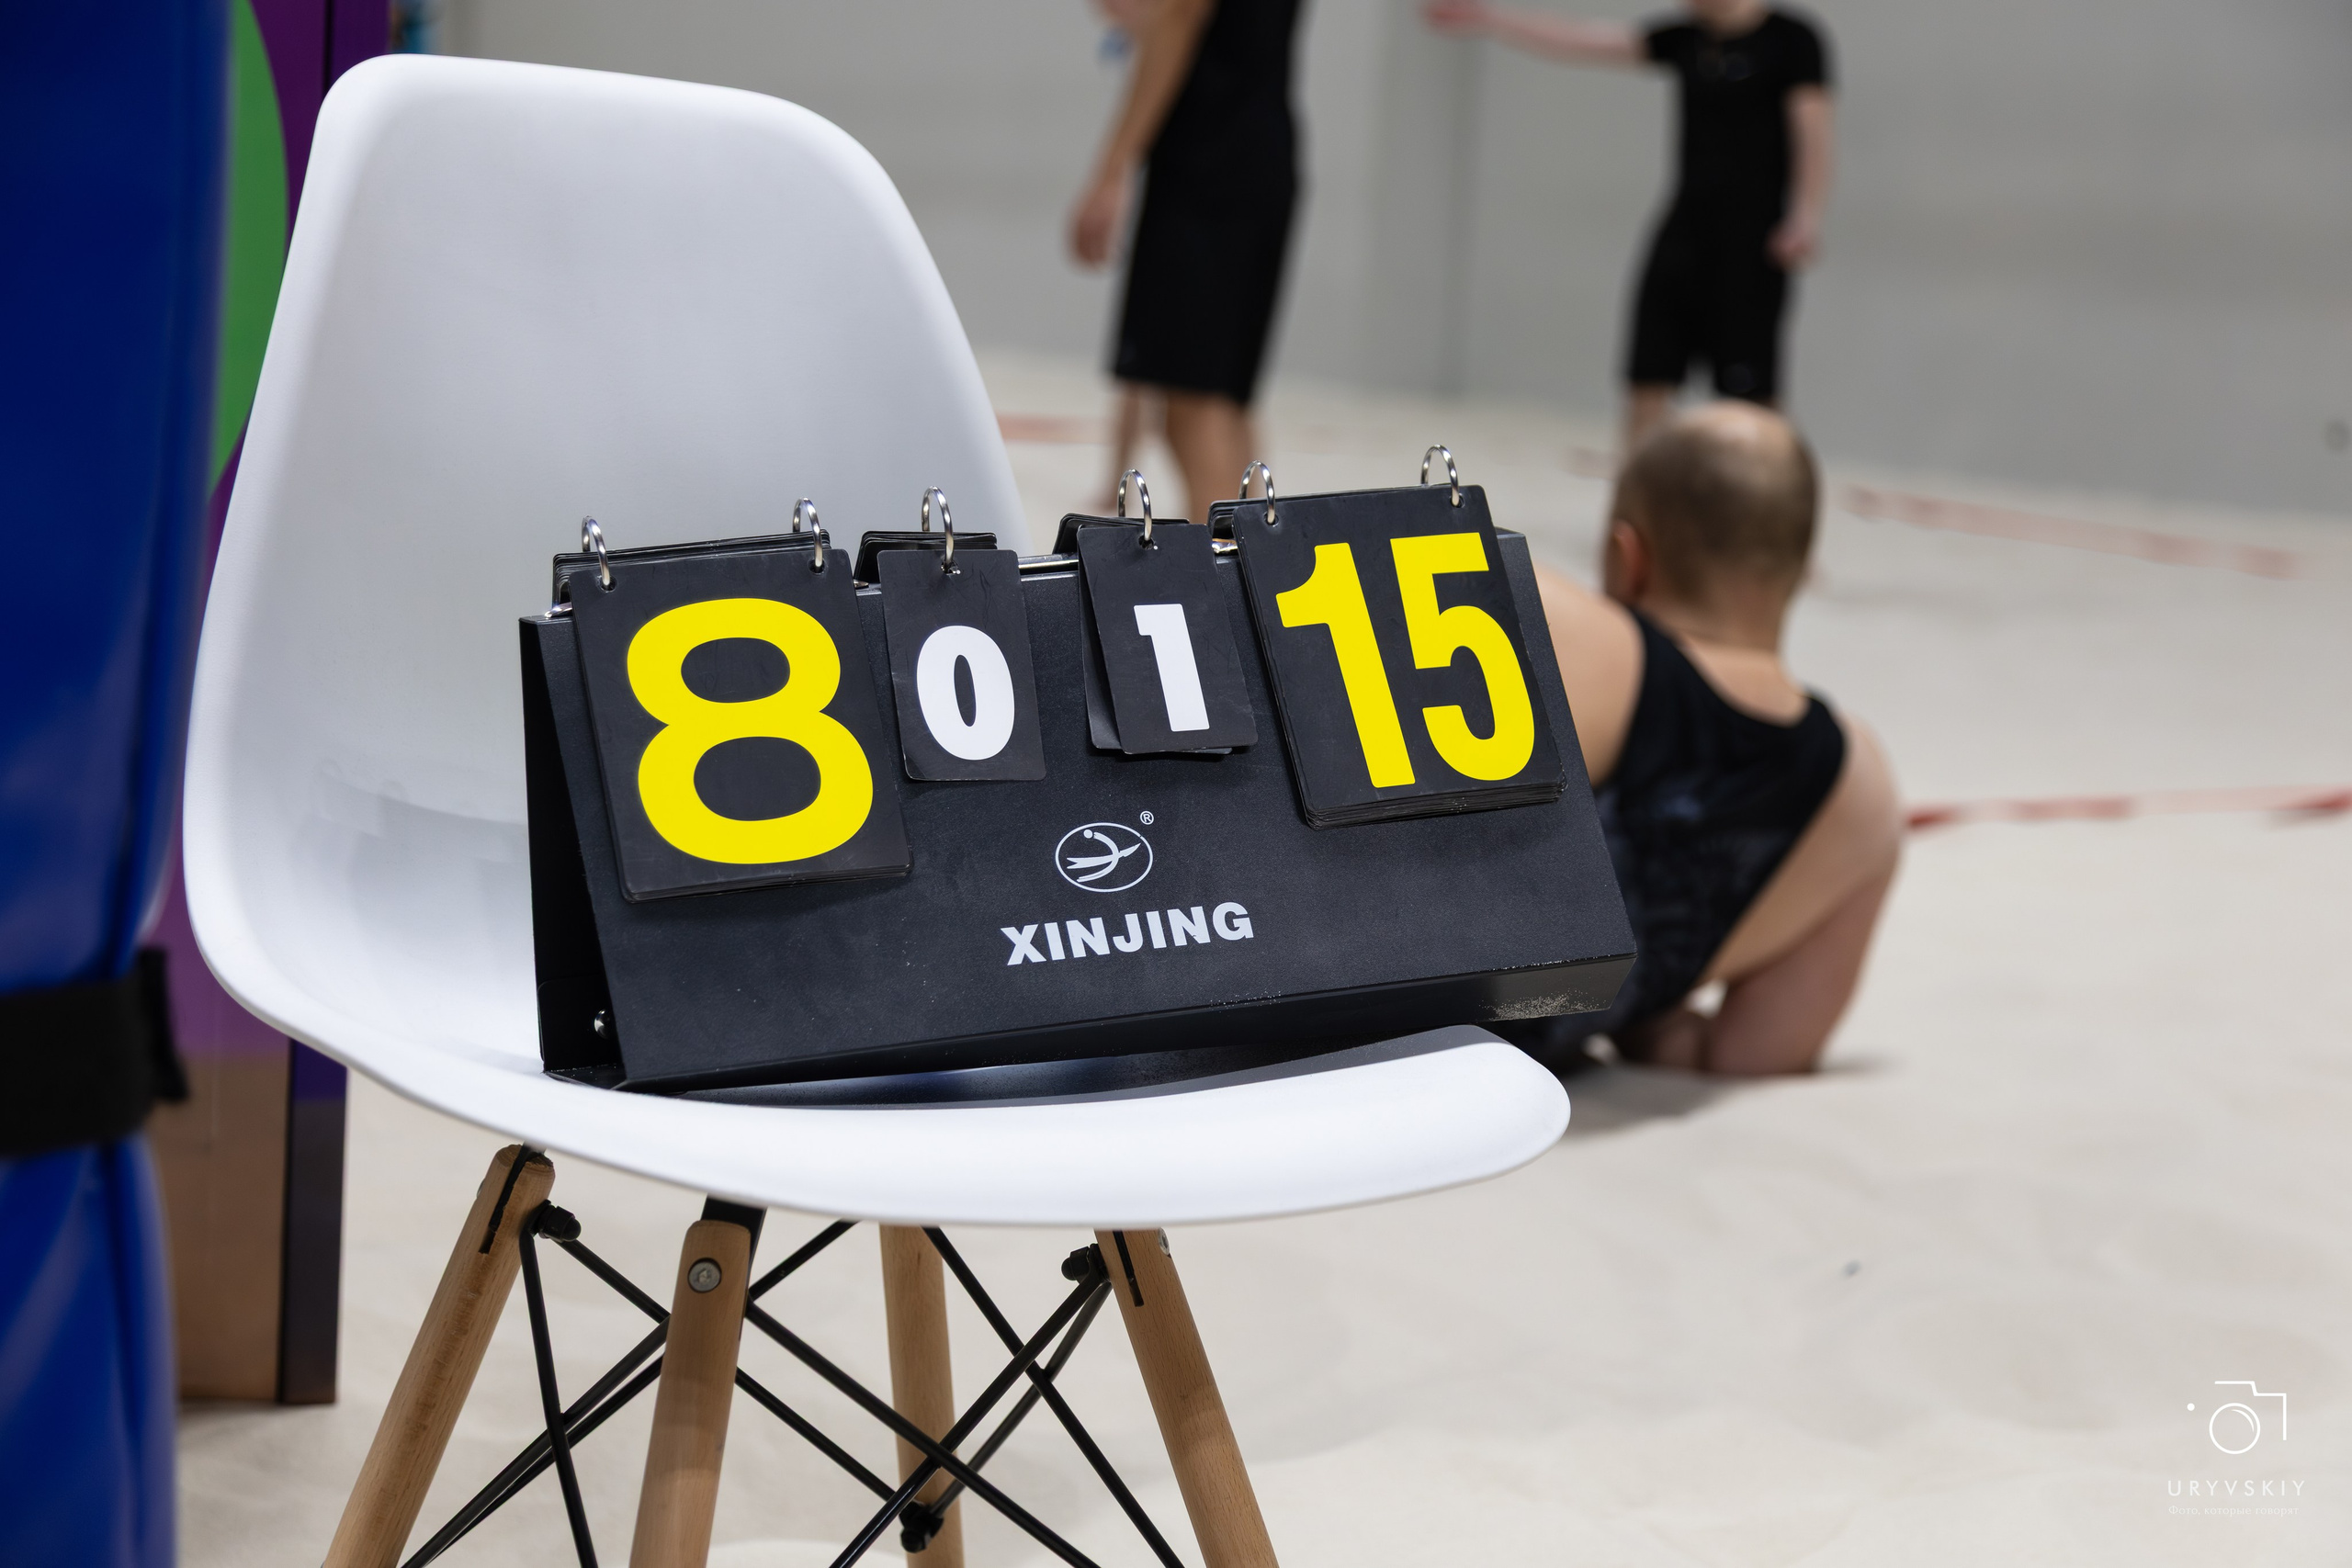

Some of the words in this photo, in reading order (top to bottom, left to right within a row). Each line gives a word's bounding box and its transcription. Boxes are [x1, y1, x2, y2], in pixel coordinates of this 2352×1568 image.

[916, 625, 1015, 761] 0
[1133, 603, 1210, 732] 1
[1275, 532, 1535, 788] 15
[627, 597, 874, 864] 8
[1000, 901, 1255, 966] XINJING
